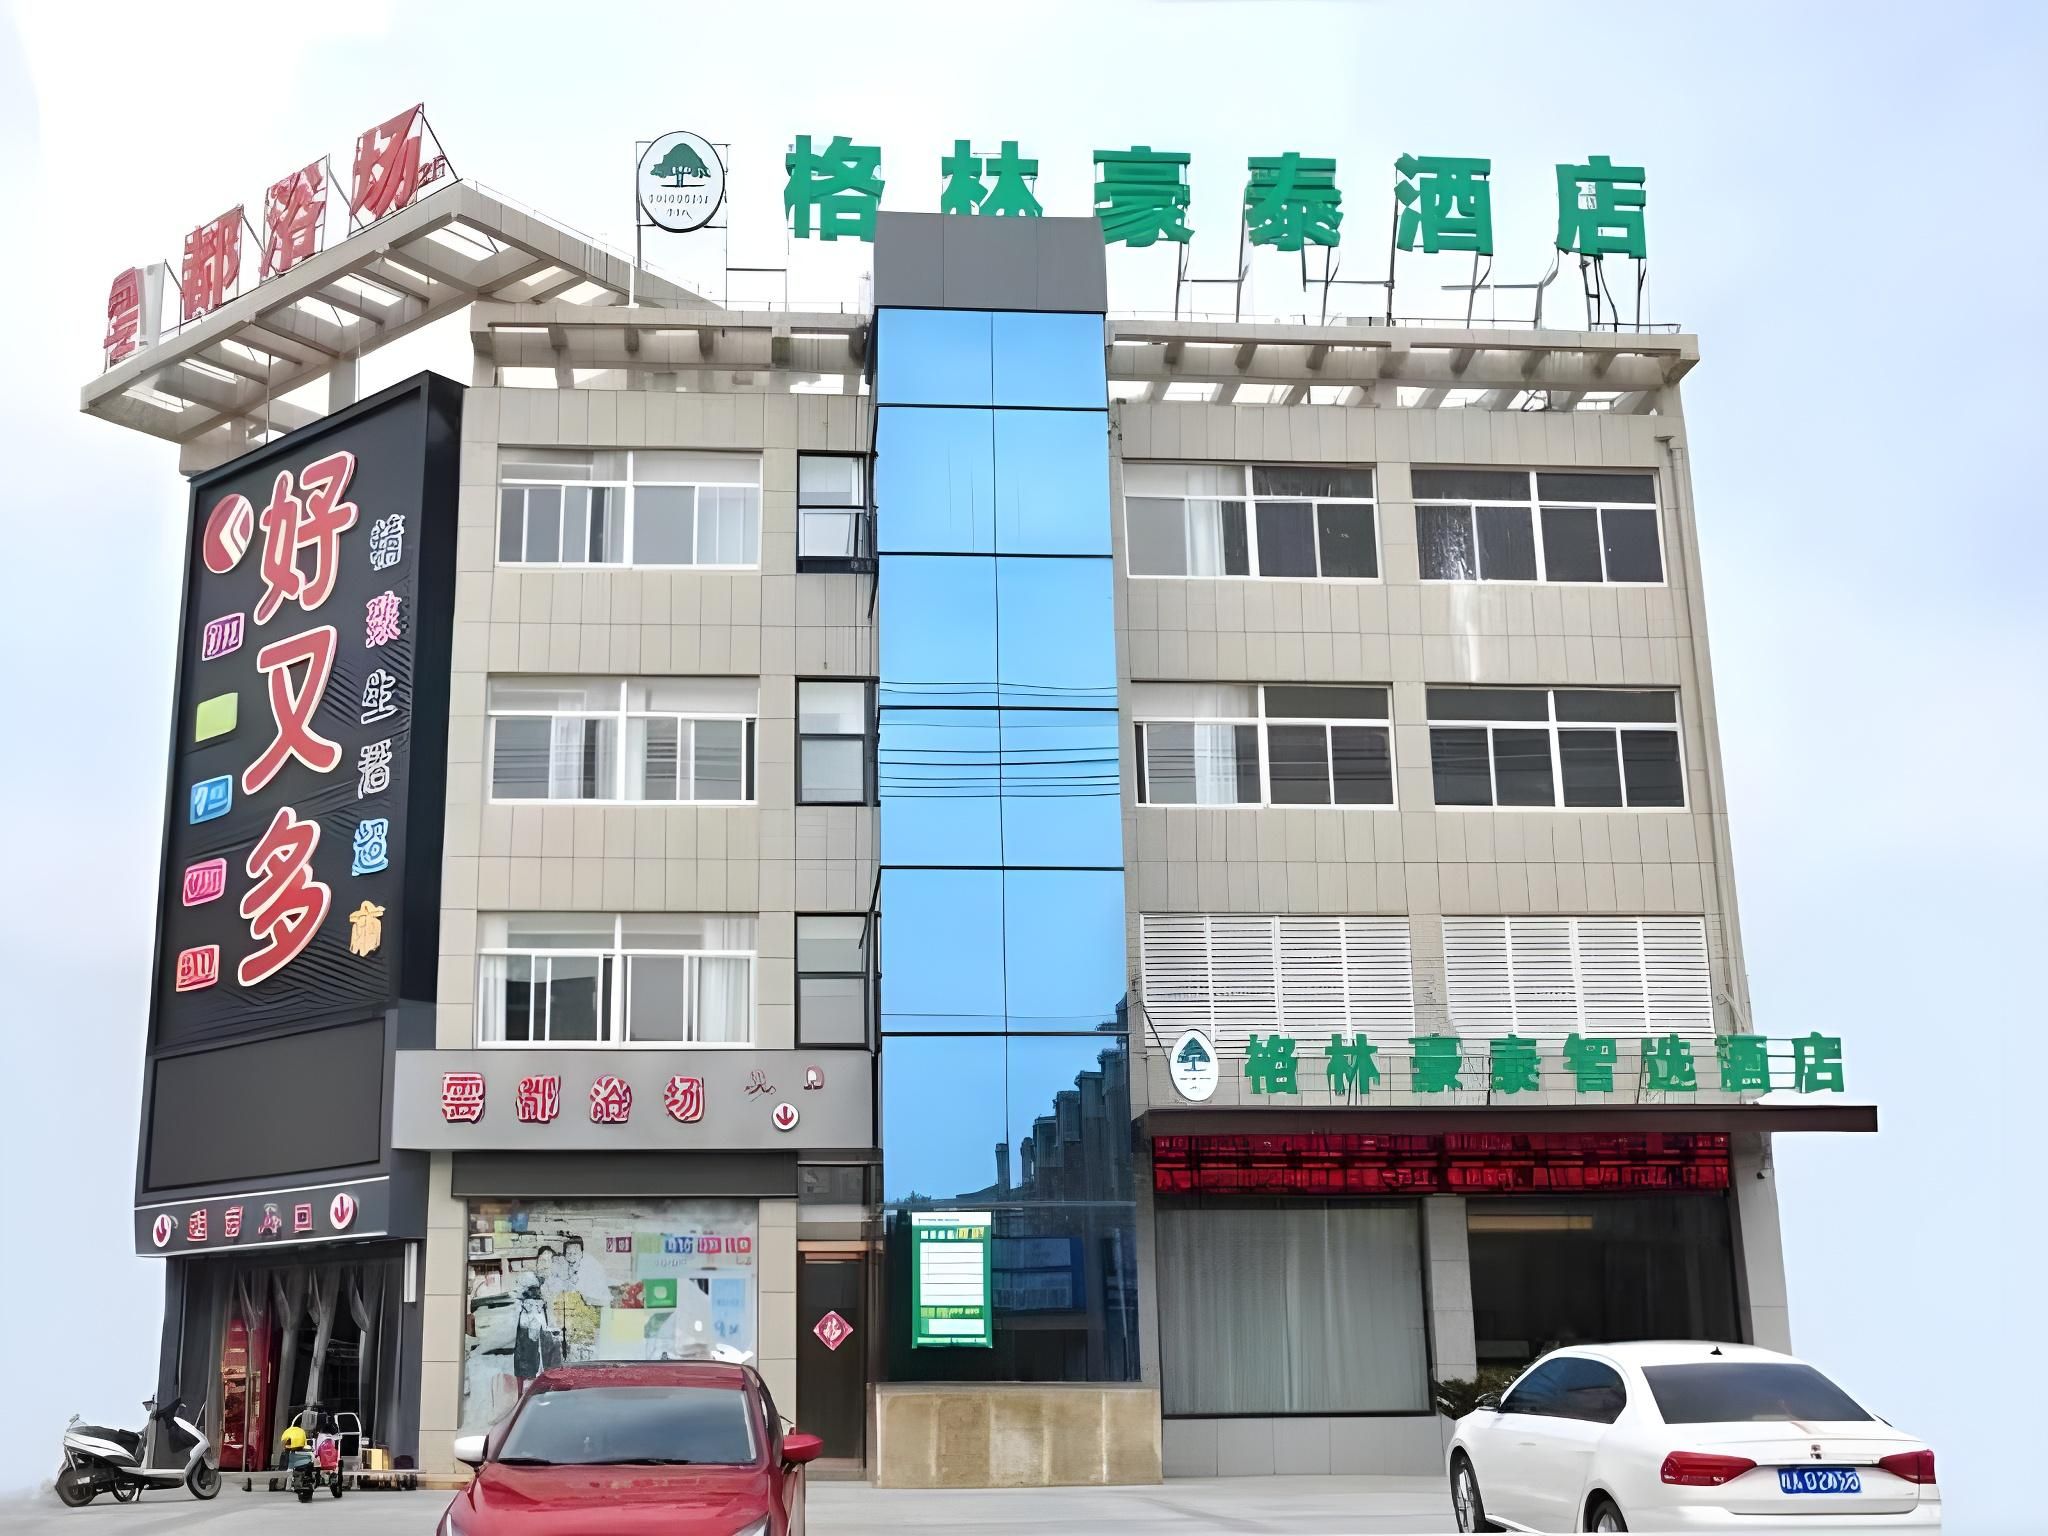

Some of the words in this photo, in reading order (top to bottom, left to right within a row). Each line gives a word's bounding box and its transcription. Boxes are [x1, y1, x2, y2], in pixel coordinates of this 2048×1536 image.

[783, 134, 1648, 261] 格林豪泰酒店
[237, 450, 359, 988] 好又多
